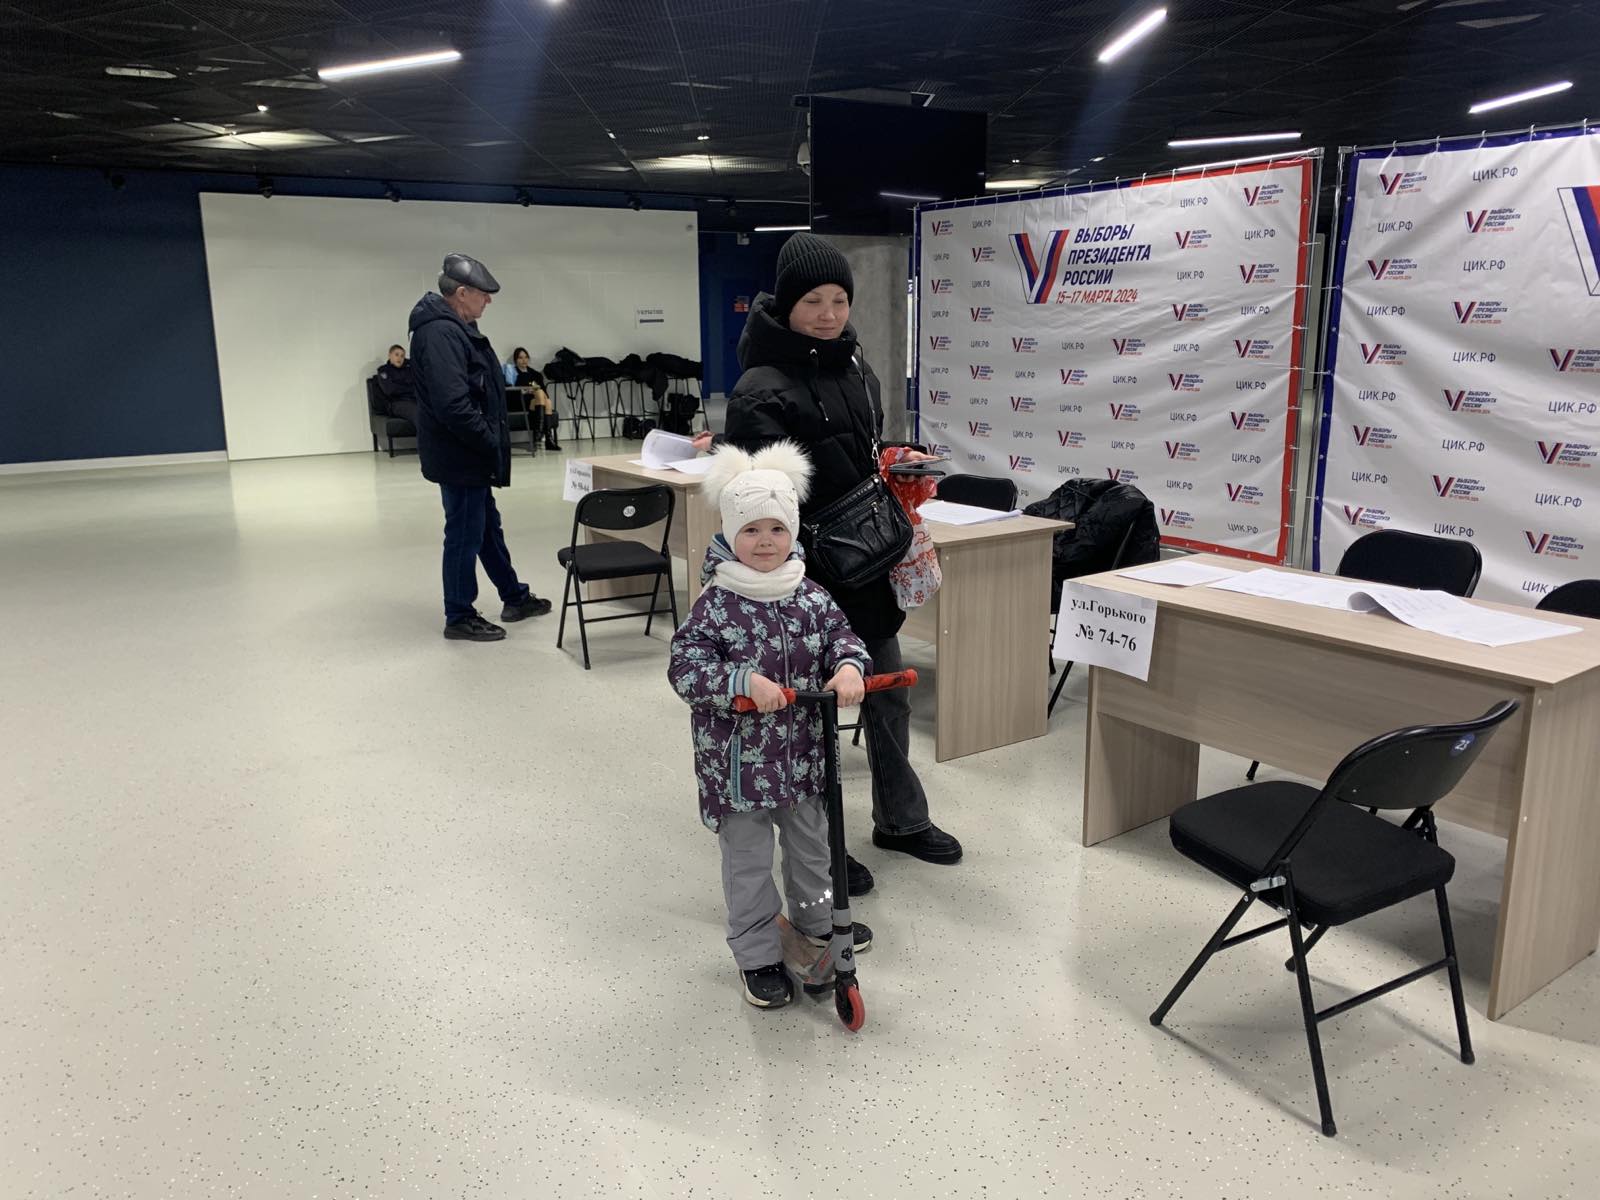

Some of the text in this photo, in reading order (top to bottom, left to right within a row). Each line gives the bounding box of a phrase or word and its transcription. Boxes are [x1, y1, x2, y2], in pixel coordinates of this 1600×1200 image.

[1472, 166, 1519, 182] ЦИК.РФ
[1377, 221, 1413, 233] ЦИК.РФ
[1074, 224, 1135, 244] ВЫБОРЫ
[1244, 228, 1276, 240] ЦИК.РФ
[1067, 244, 1152, 265] ПРЕЗИДЕНТА
[1463, 259, 1506, 272] ЦИК.РФ
[1062, 269, 1114, 286] РОССИИ
[1176, 270, 1205, 281] ЦИК.РФ
[1082, 290, 1112, 303] МАРТА
[1114, 289, 1138, 302] 2024
[1366, 306, 1406, 317] ЦИК.РФ
[1173, 343, 1200, 353] ЦИК.РФ
[1452, 351, 1497, 363] ЦИК.РФ
[1235, 380, 1267, 391] ЦИК.РФ
[1358, 390, 1396, 401] ЦИК.РФ
[1548, 401, 1598, 414] ЦИК.РФ
[1169, 412, 1198, 423] ЦИК.РФ
[1442, 439, 1485, 452] ЦИК.РФ
[1231, 452, 1262, 464] ЦИК.РФ
[1351, 471, 1388, 485] ЦИК.РФ
[1166, 480, 1193, 491] ЦИК.РФ
[1535, 493, 1582, 508] ЦИК.РФ
[1227, 523, 1259, 535] ЦИК.РФ
[1434, 523, 1474, 537] ЦИК.РФ
[1071, 599, 1146, 624] ул.Горького
[1075, 624, 1137, 651] № 74-76
